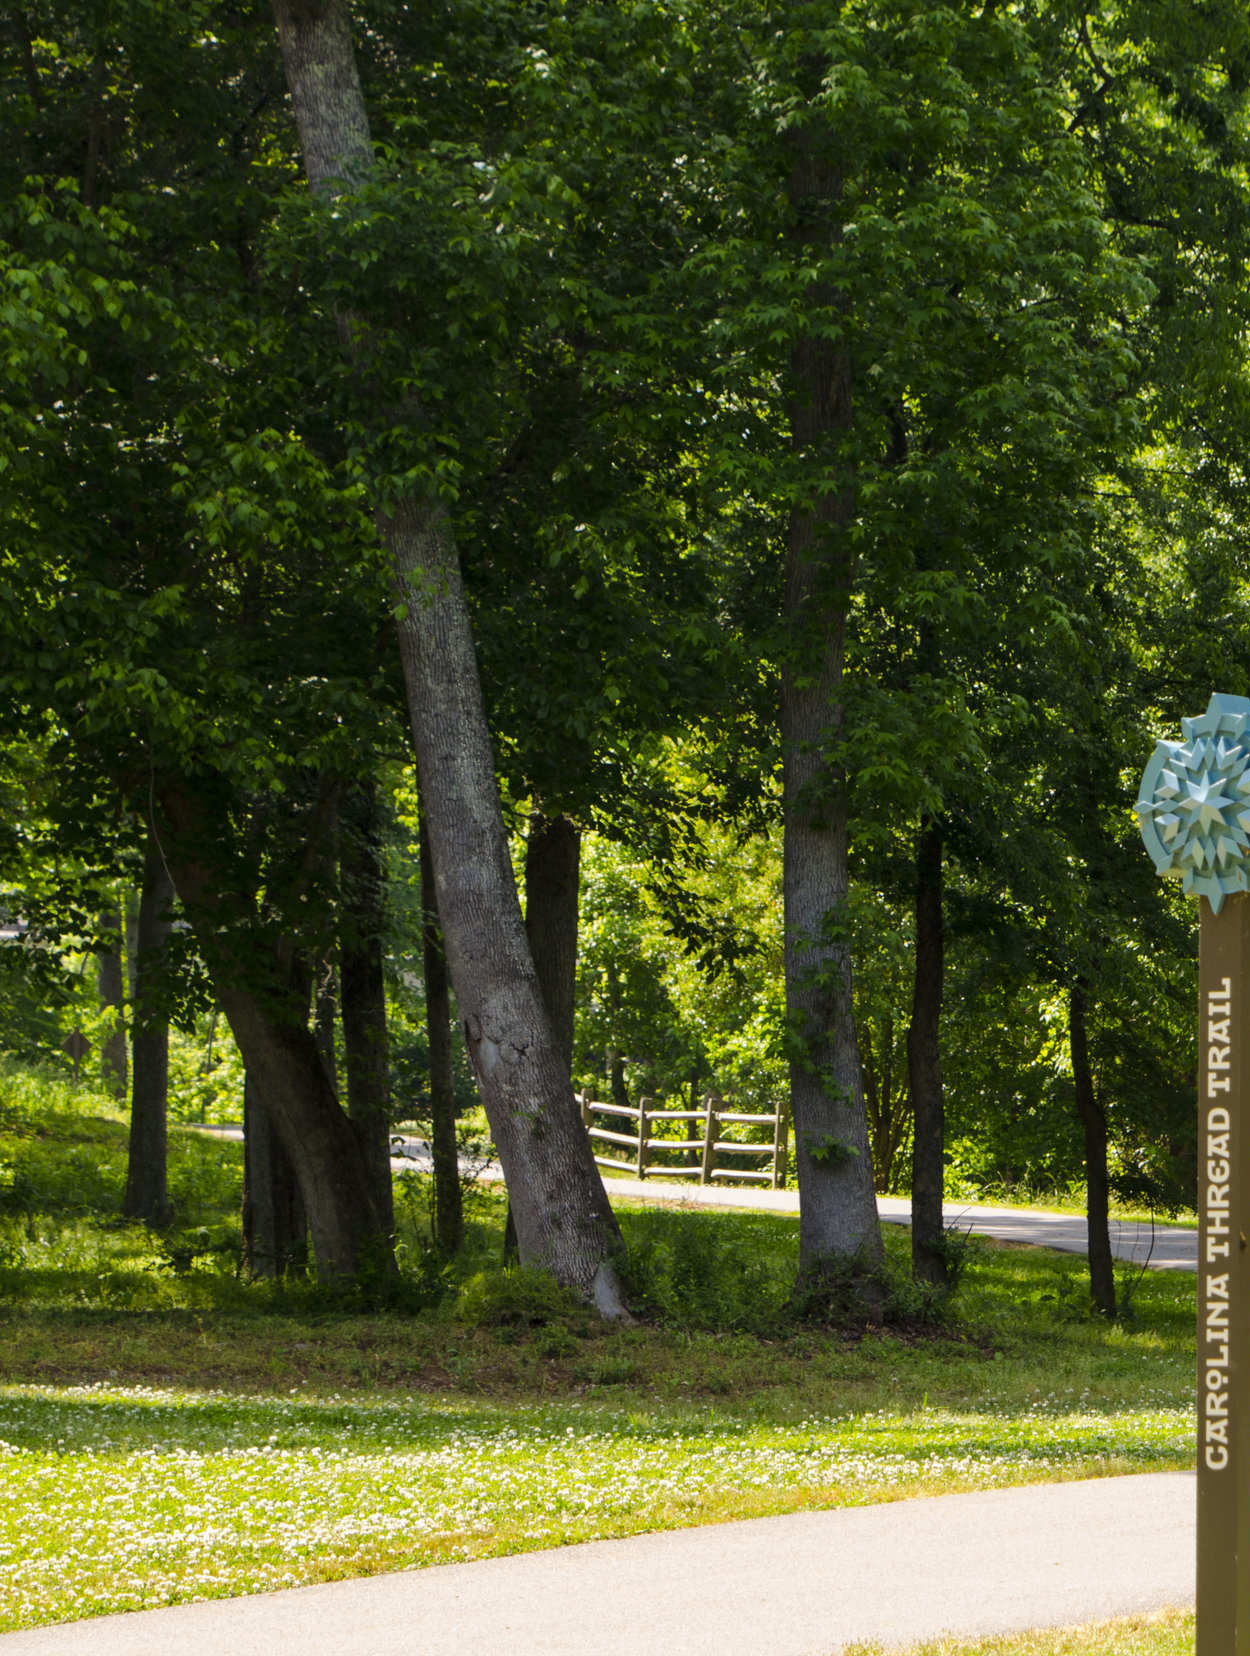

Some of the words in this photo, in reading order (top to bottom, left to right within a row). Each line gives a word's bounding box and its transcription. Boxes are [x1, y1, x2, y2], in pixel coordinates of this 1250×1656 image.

[1206, 977, 1232, 1098] TRAIL
[1205, 1107, 1231, 1263] THREAD
[1204, 1273, 1230, 1472] CAROLINA
